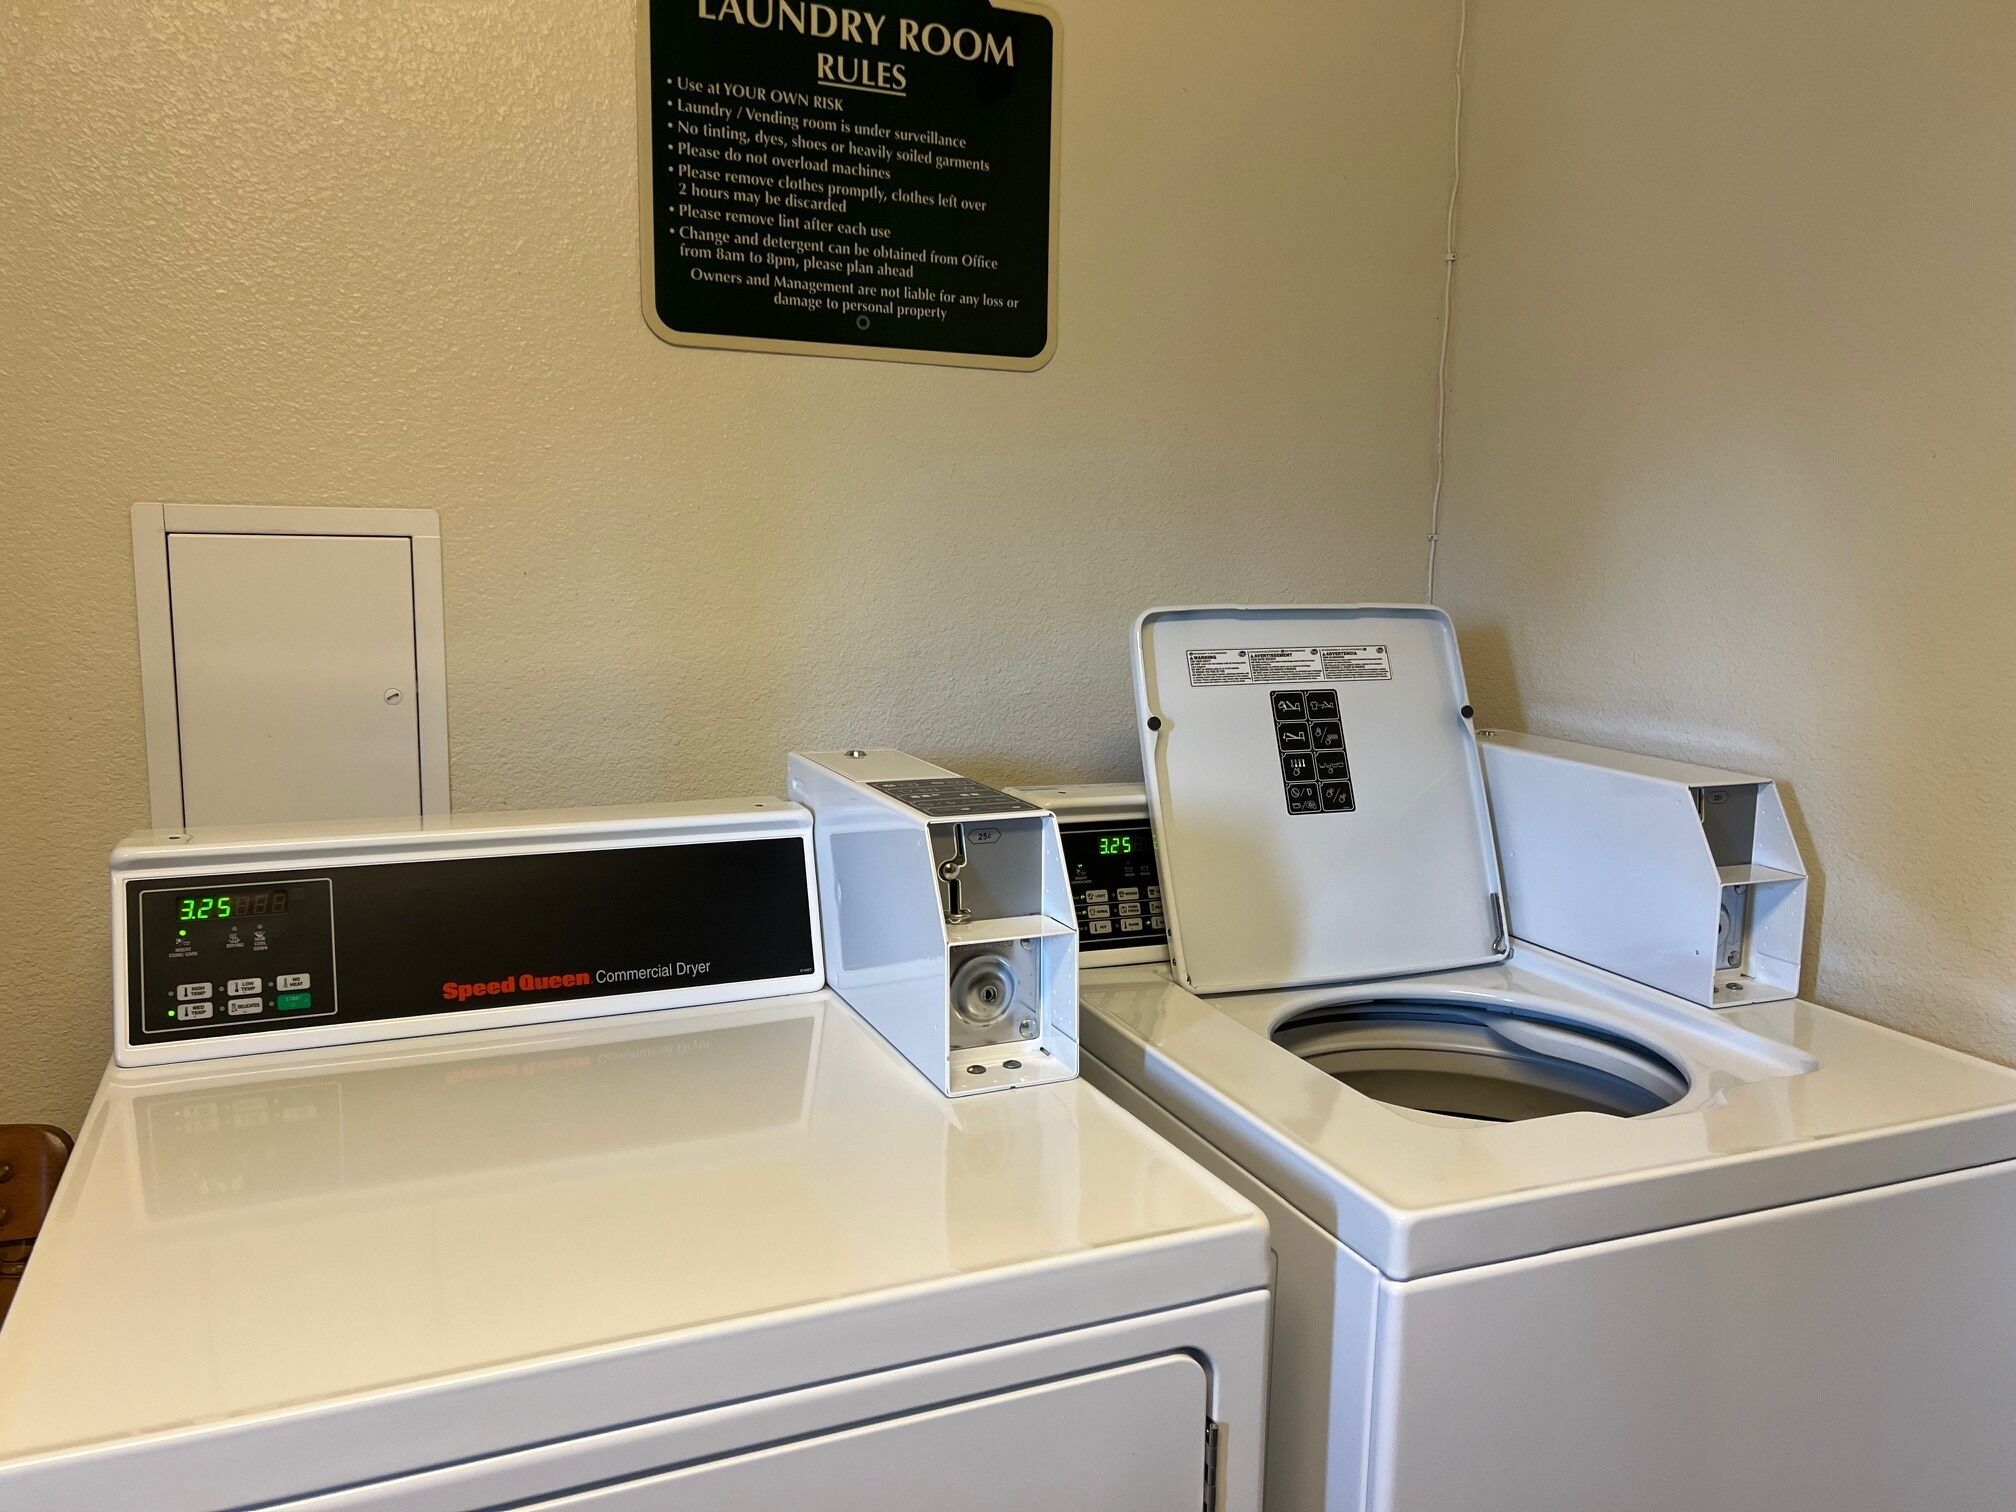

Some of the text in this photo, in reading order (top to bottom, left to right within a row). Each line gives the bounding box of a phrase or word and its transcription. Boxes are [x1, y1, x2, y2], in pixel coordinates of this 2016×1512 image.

[698, 0, 1014, 67] LAUNDRY ROOM
[818, 53, 906, 90] RULES
[677, 76, 843, 112] Use at YOUR OWN RISK
[677, 98, 732, 122] Laundry
[745, 107, 799, 130] Vending
[803, 118, 837, 131] room
[841, 119, 851, 133] is
[854, 123, 891, 138] under
[894, 130, 966, 148] surveillance
[678, 120, 990, 171] No tinting, dyes, shoes or heavily soiled garments
[678, 142, 891, 179] Please do not overload machines
[678, 164, 987, 211] Please remove clothes promptly, clothes left over
[679, 182, 847, 213] 2 hours may be discarded
[679, 204, 891, 238] Please remove lint after each use
[679, 225, 998, 270] Change and detergent can be obtained from Office
[680, 242, 914, 278] from 8am to 8pm, please plan ahead
[690, 268, 1019, 308] Owners and Management are not liable for any loss or
[773, 291, 947, 322] damage to personal property
[1100, 837, 1131, 855] 3.25
[180, 897, 231, 920] 3.25
[442, 972, 591, 1002] Speed Queen
[595, 962, 711, 984] Commercial Dryer
